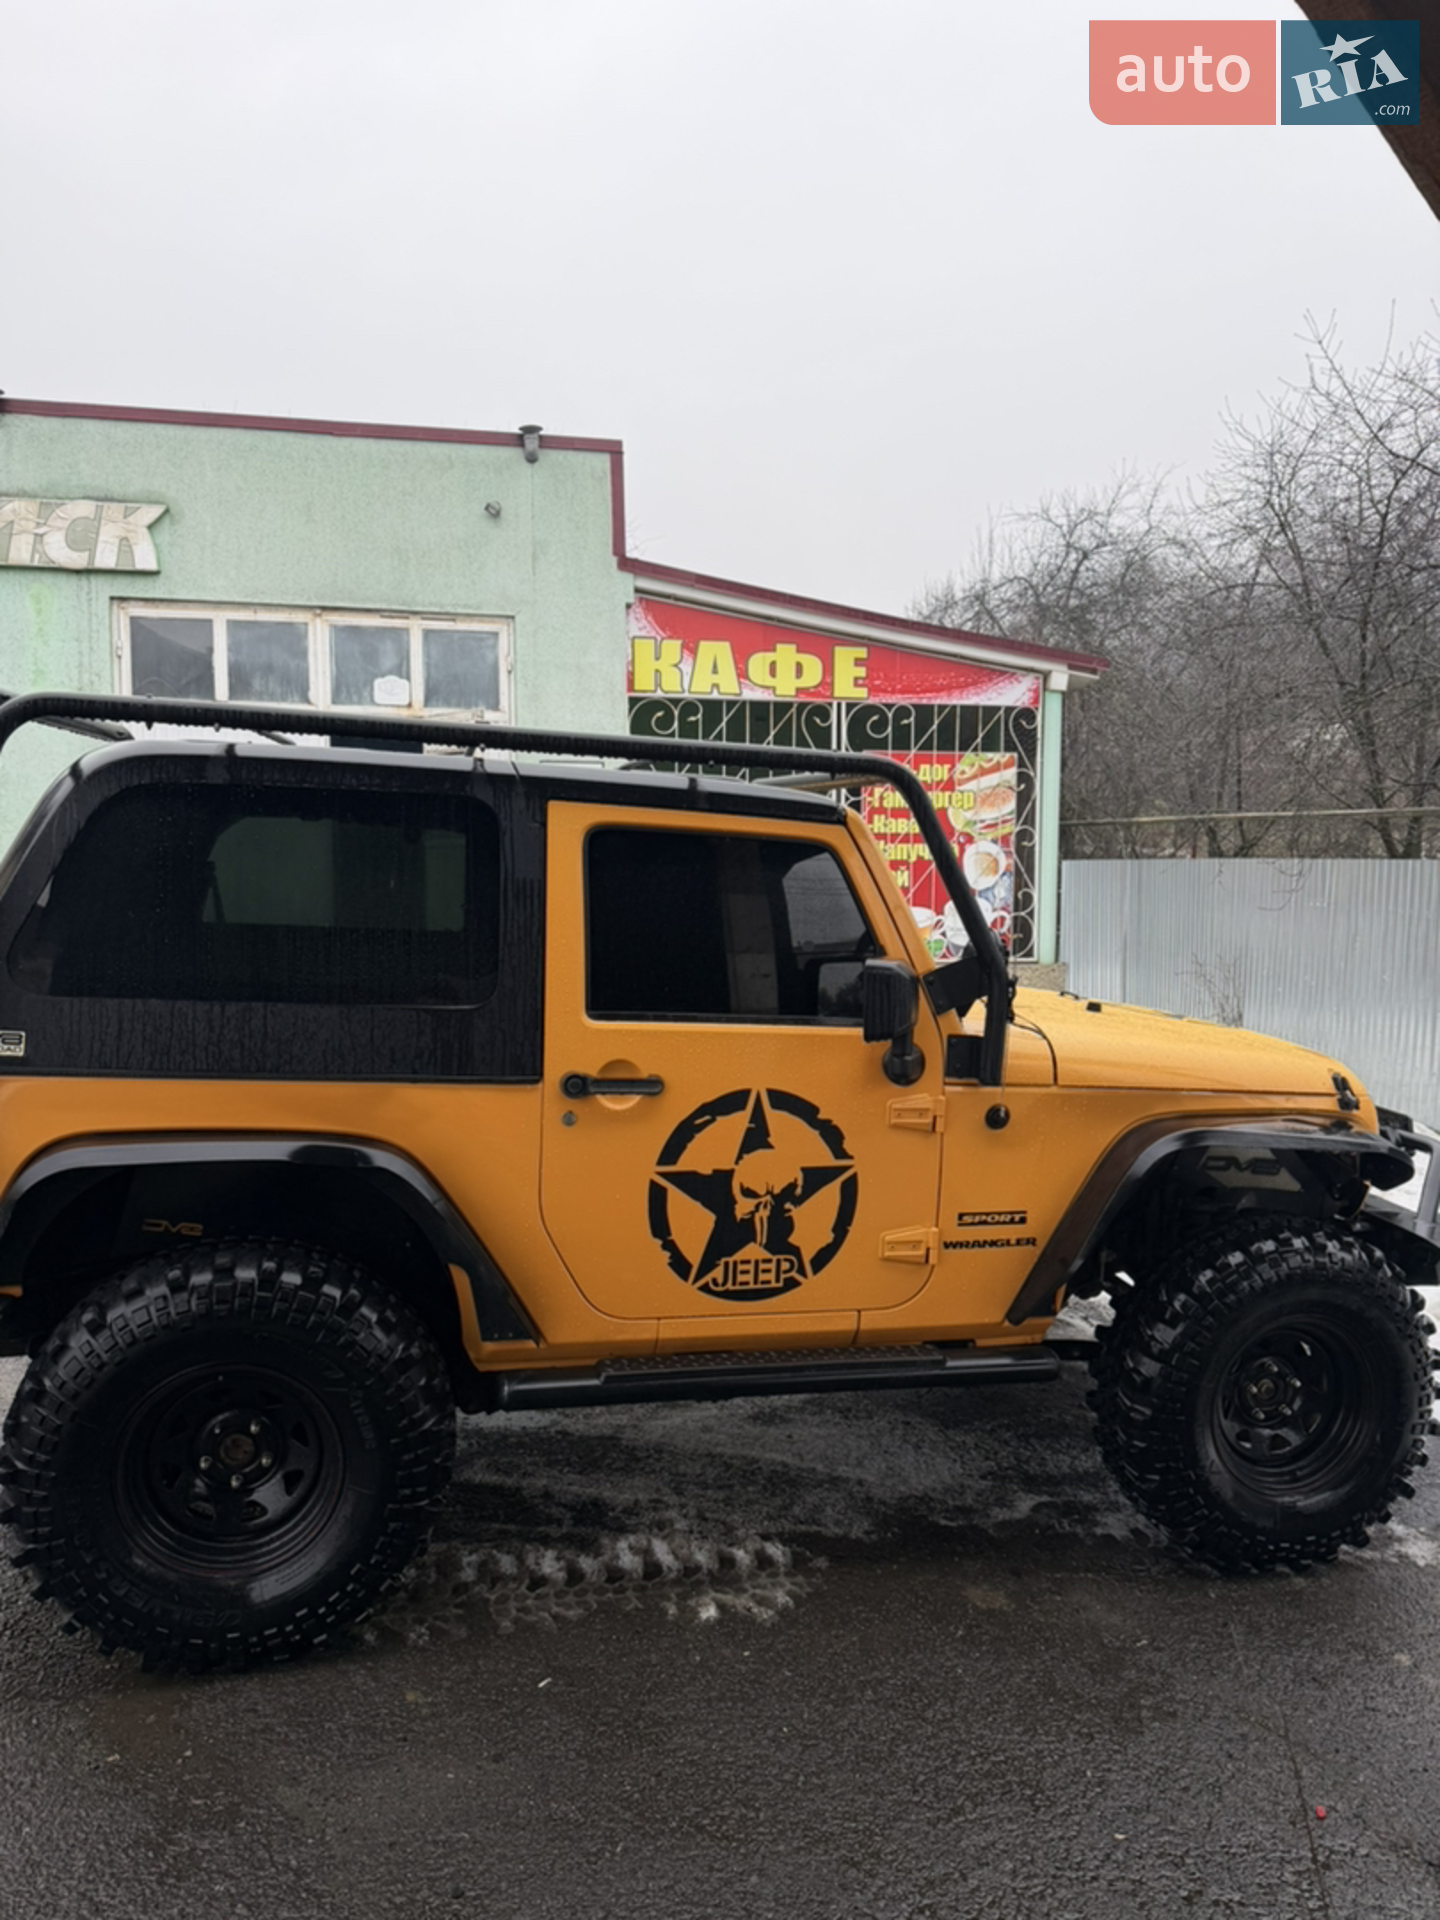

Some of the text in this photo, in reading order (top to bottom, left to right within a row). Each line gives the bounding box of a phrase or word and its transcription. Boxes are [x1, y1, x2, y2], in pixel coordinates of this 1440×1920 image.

[632, 636, 869, 700] КАФЕ
[960, 1212, 1024, 1225] SPORT
[942, 1237, 1037, 1250] WRANGLER
[709, 1256, 797, 1289] JEEP
